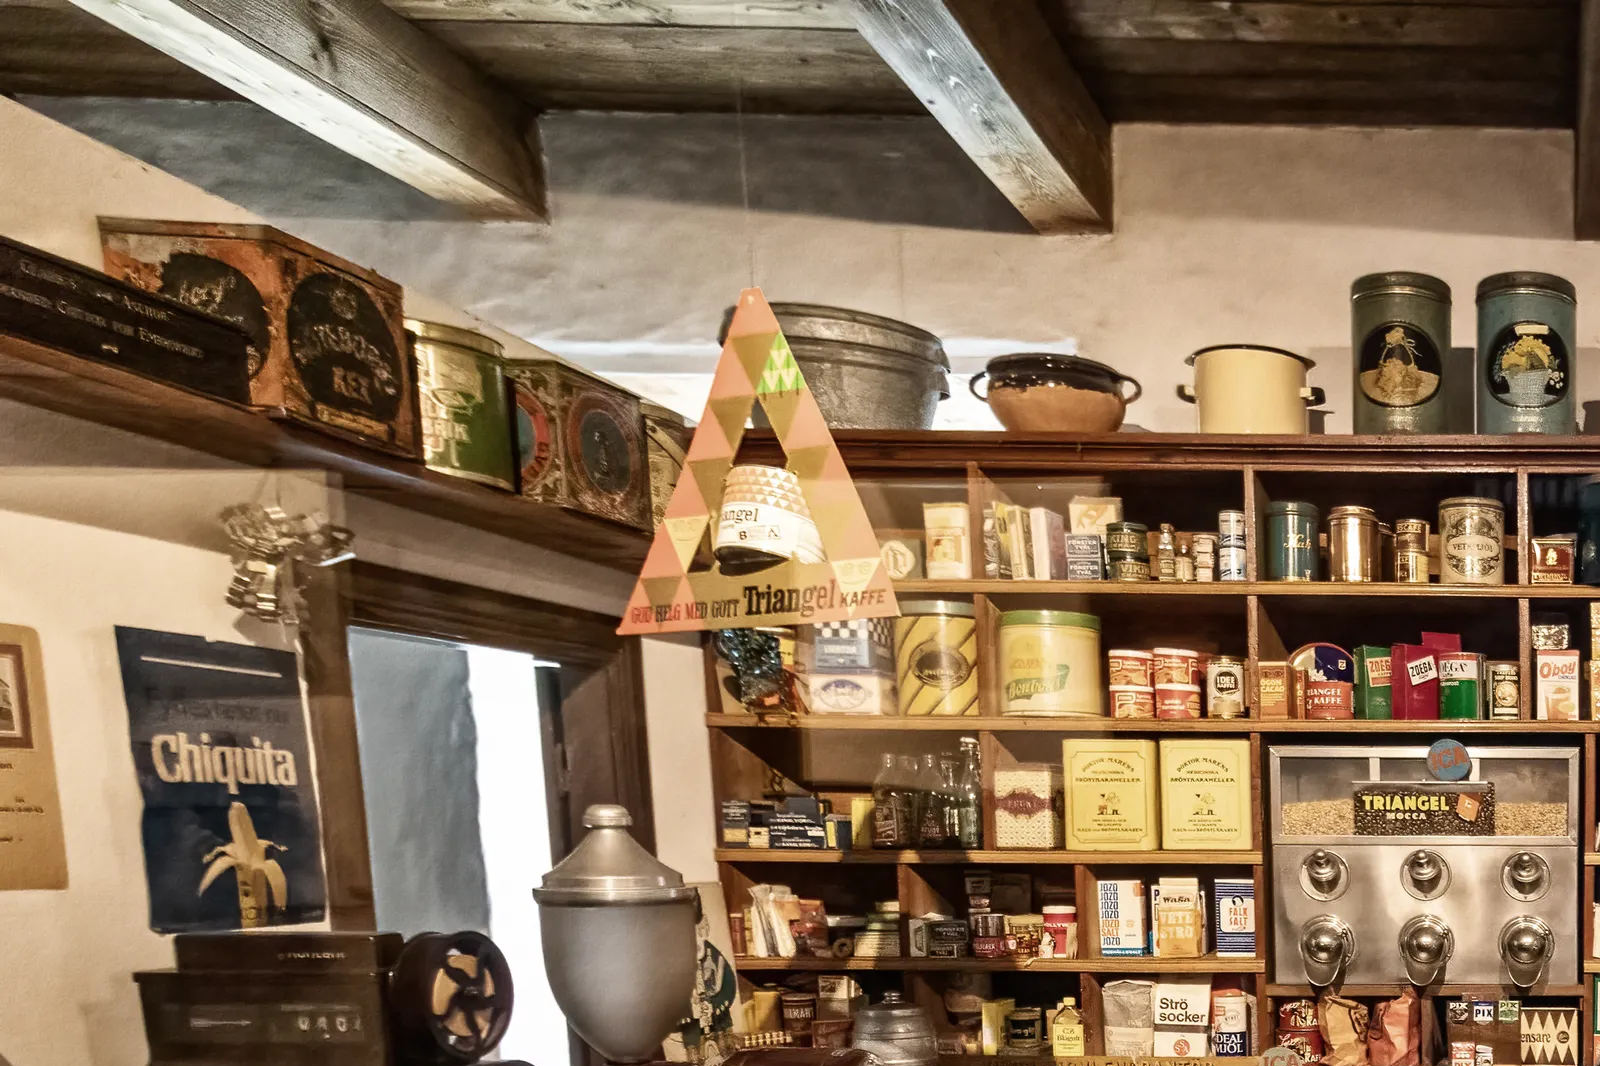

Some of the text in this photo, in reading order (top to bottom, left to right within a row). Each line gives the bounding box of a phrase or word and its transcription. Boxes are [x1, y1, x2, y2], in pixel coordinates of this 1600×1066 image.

[722, 508, 759, 524] angel
[1120, 562, 1150, 575] VIKIN
[685, 602, 708, 620] MED
[712, 599, 740, 619] GOTT
[744, 581, 836, 617] Triangel
[840, 589, 887, 607] KAFFE
[1369, 659, 1392, 673] ZOÉG
[1216, 676, 1235, 684] IDEE
[1307, 688, 1342, 696] RIANGEL
[1313, 696, 1343, 704] KAFFE
[1430, 745, 1470, 771] ICA
[151, 732, 297, 794] Chiquita
[1362, 795, 1450, 811] TRIANGEL
[1386, 812, 1427, 820] MOCCA
[1100, 883, 1118, 892] JOZO
[1100, 892, 1119, 901] JOZO
[1101, 901, 1119, 910] JOZO
[1101, 910, 1120, 919] JOZO
[1229, 907, 1248, 917] FALK
[1102, 919, 1120, 928] JOZO
[1229, 917, 1248, 926] SALT
[1102, 928, 1120, 937] SALT
[1103, 937, 1121, 946] JOZO
[1159, 997, 1188, 1010] Strö
[1449, 1002, 1468, 1010] PIX
[1159, 1011, 1206, 1023] socker
[1475, 1008, 1493, 1018] PIX
[1215, 1033, 1243, 1043] DEAL
[1521, 1033, 1551, 1043] ensare
